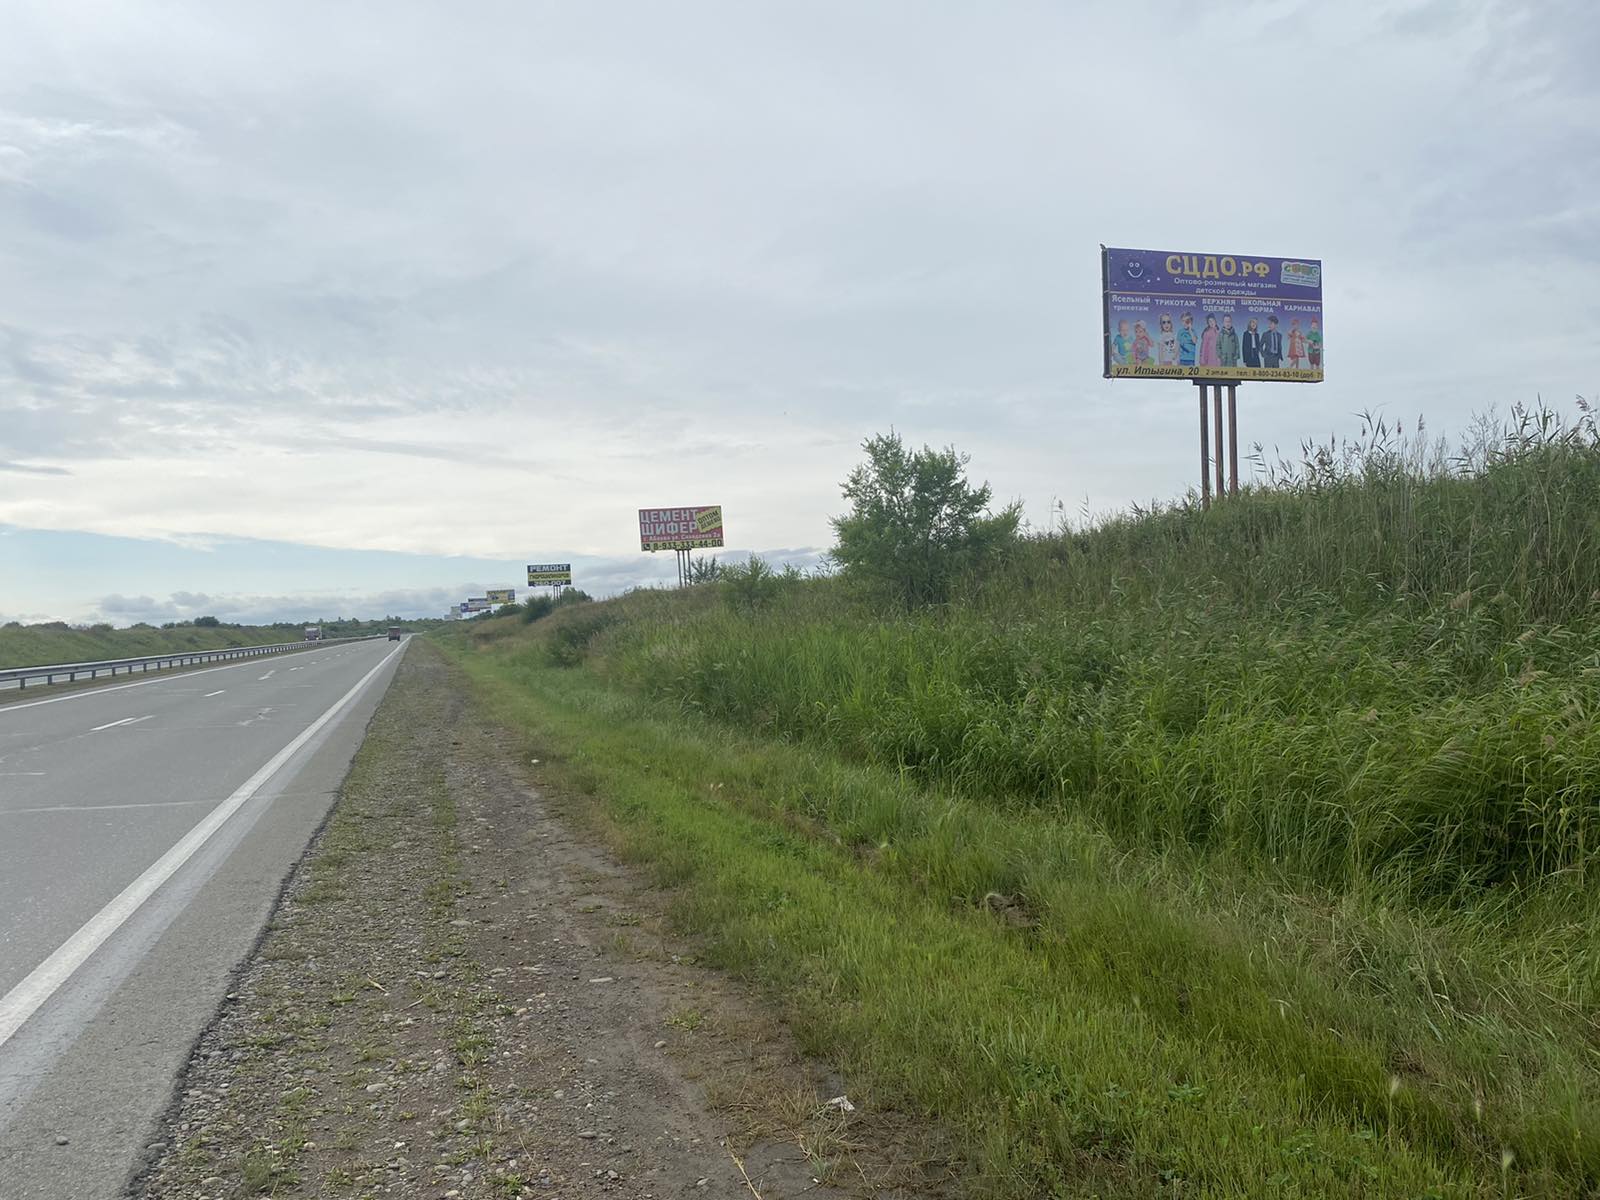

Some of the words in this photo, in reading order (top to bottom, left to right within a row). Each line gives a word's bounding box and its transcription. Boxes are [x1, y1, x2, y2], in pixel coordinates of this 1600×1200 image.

[1174, 277, 1245, 288] Оптово-розничный
[1111, 294, 1151, 304] Ясельный
[1202, 298, 1236, 306] ВЕРХНЯЯ
[1240, 299, 1281, 307] ШКОЛЬНАЯ
[1202, 305, 1235, 313] ОДЕЖДА
[1284, 305, 1321, 313] КАРНАВАЛ
[1116, 367, 1131, 377] ул.
[1188, 367, 1200, 376] 20
[640, 509, 698, 524] ЦЕМЕНТ
[641, 521, 698, 536] ШИФЕР
[529, 564, 568, 573] РЕМОНТ
